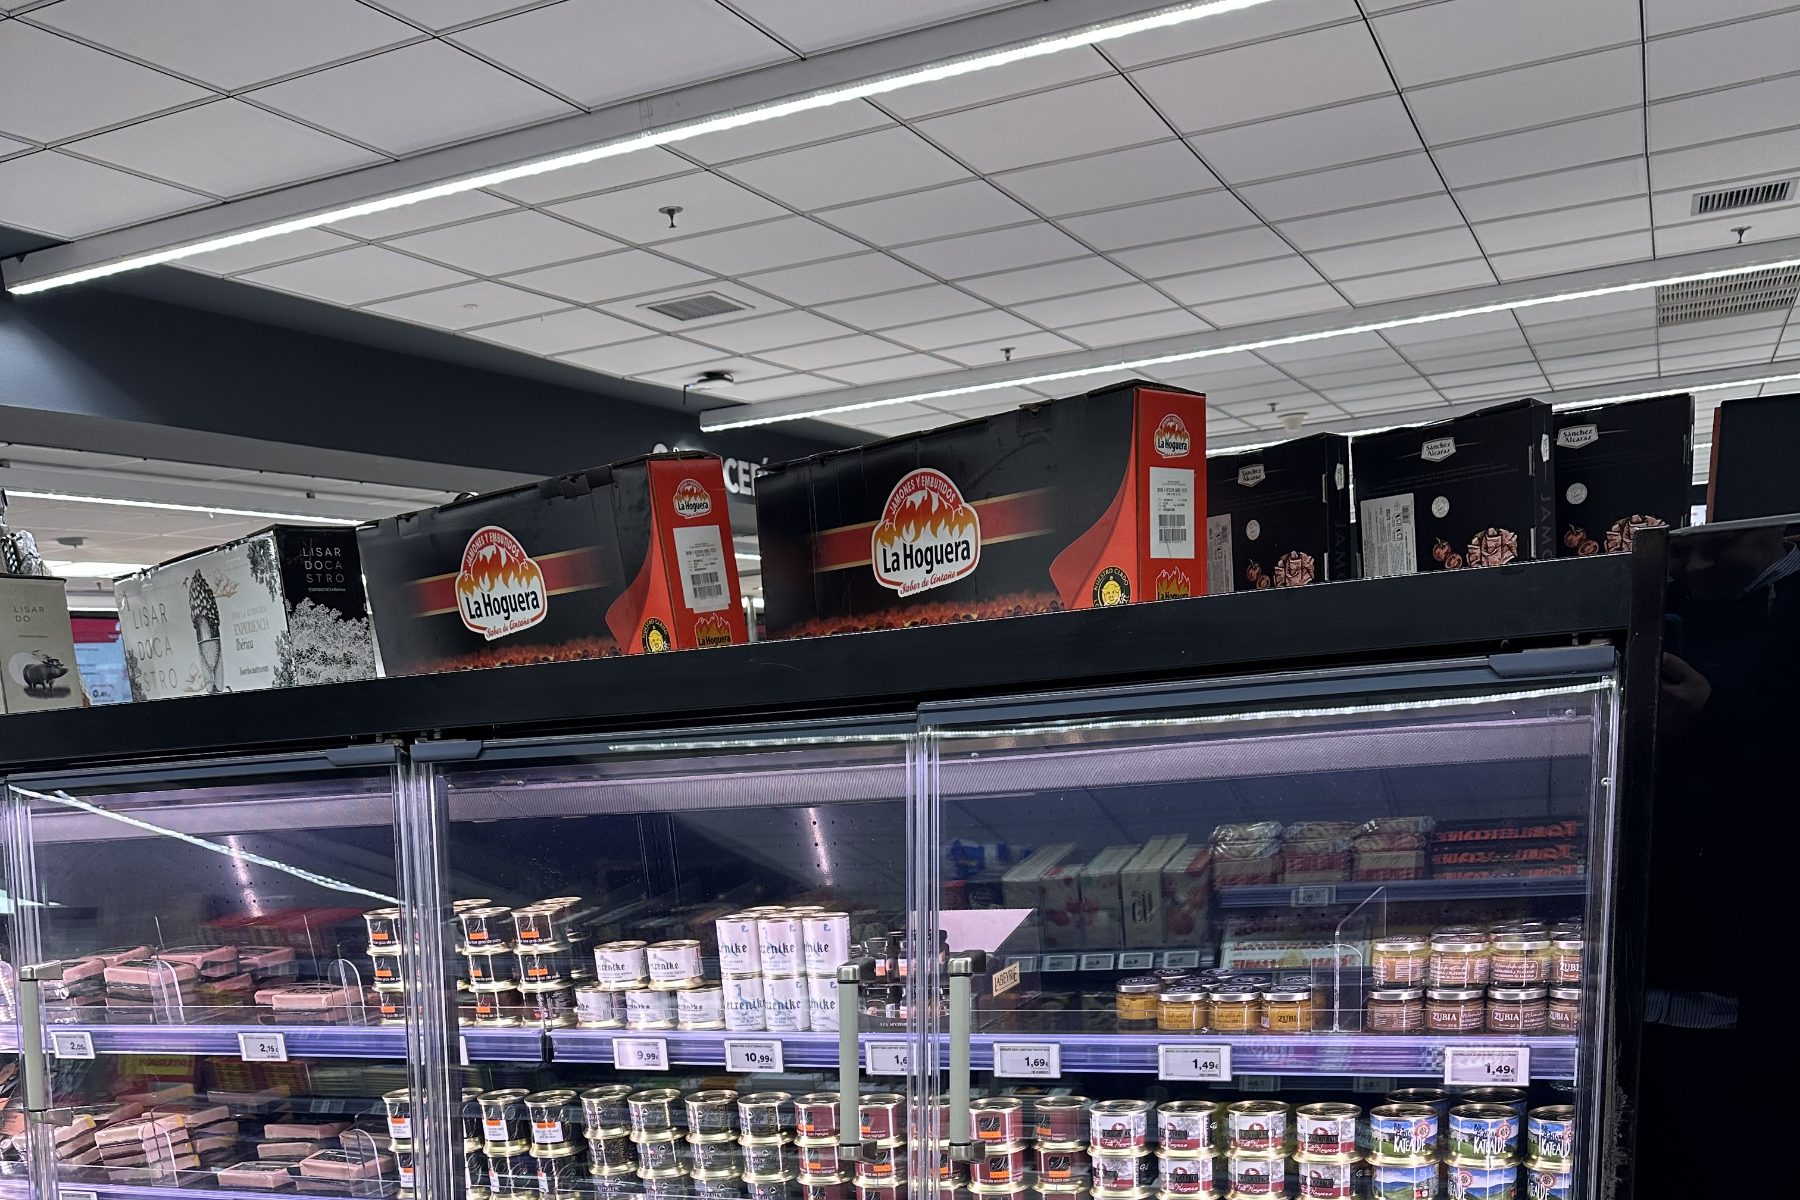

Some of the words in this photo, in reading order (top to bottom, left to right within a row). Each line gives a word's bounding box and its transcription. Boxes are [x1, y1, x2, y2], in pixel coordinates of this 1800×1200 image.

[890, 479, 914, 514] JAMONES
[921, 475, 956, 503] EMBUTIDOS
[302, 547, 342, 558] LISAR
[882, 548, 901, 574] La
[902, 539, 971, 575] Hoguera
[304, 560, 343, 571] DOCA
[306, 573, 345, 584] STRO
[13, 605, 46, 614] LISAR
[465, 596, 483, 620] La
[481, 589, 541, 621] Hoguera
[15, 615, 31, 623] DO
[132, 602, 169, 630] LISAR
[138, 638, 174, 662] DOCA
[142, 667, 178, 693] STRO
[1432, 1012, 1457, 1022] ZUBIA
[1493, 1011, 1519, 1021] ZUBIA
[636, 1050, 660, 1062] 9,99€
[744, 1052, 774, 1064] 10,99€
[1024, 1056, 1049, 1068] 1,69€
[1192, 1058, 1219, 1071] 1,49€
[1484, 1062, 1516, 1076] 1,49€
[1393, 1135, 1426, 1154] KATEALDE
[1473, 1135, 1507, 1155] KATEALDE
[1541, 1139, 1570, 1159] KATEALD
